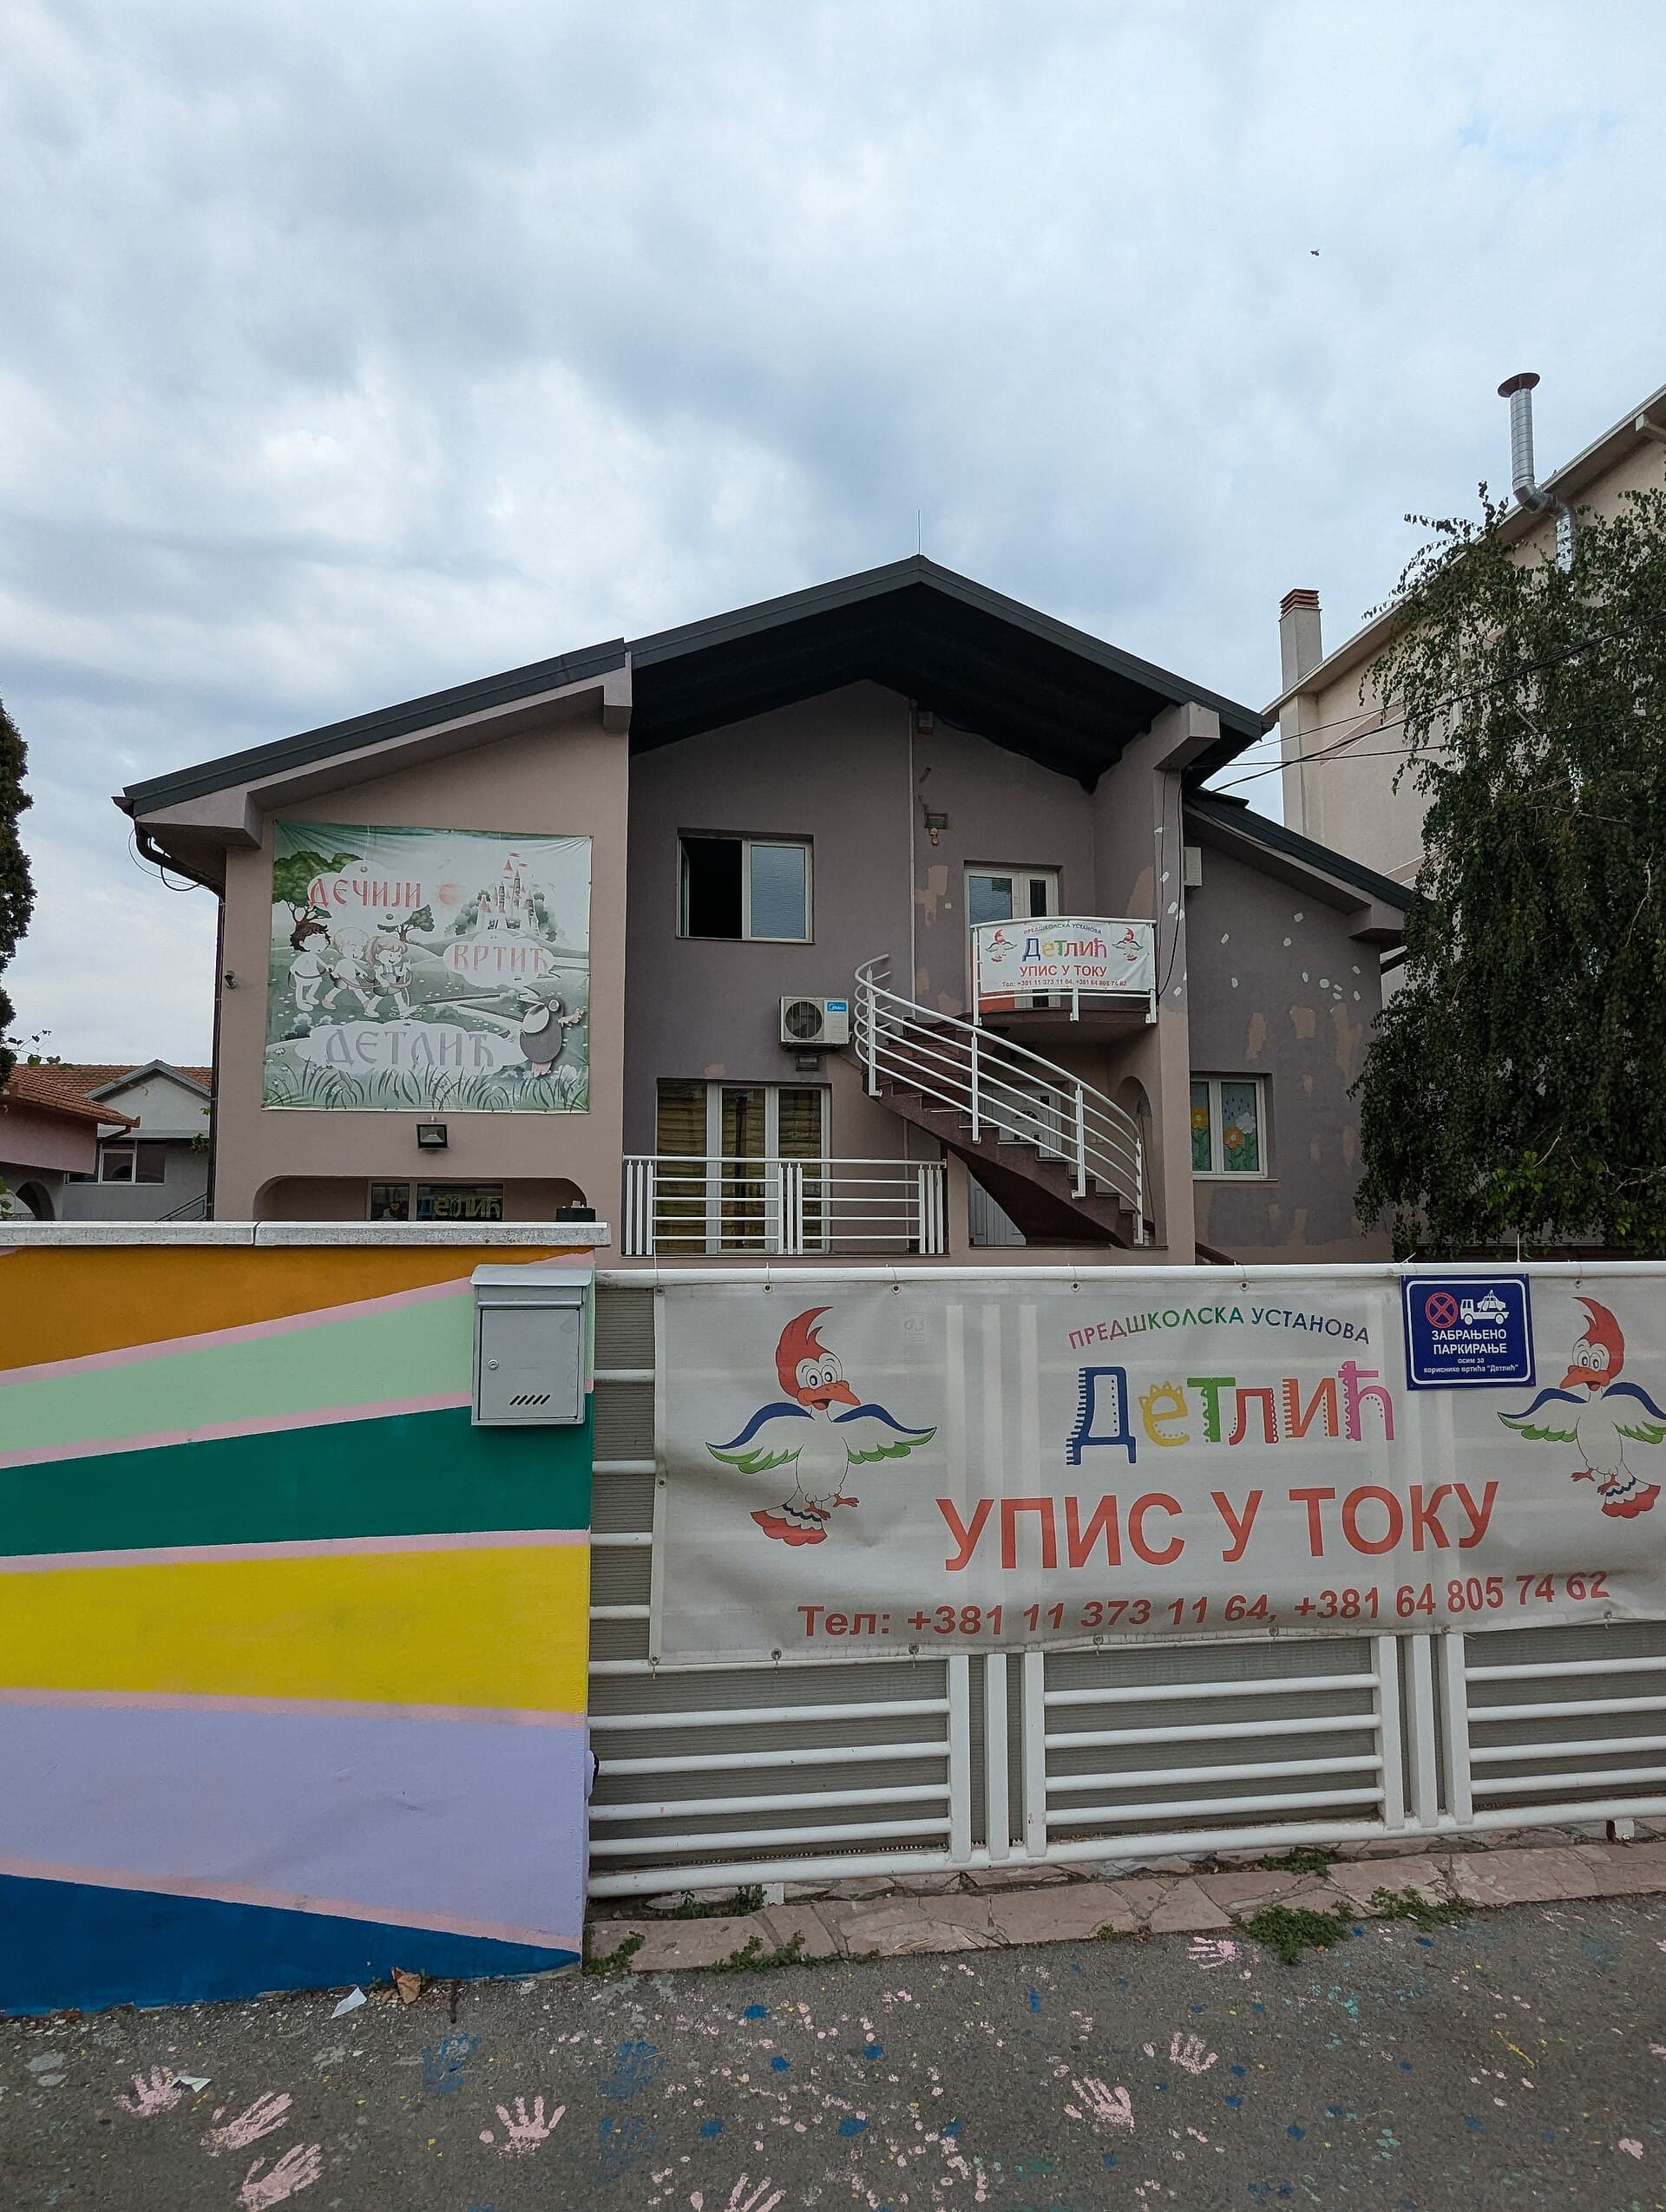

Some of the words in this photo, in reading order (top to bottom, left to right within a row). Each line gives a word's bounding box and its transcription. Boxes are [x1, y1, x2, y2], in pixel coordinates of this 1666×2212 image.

[308, 878, 423, 909] ДЕЧИЈИ
[453, 943, 548, 973] ВРТИЋ
[1021, 938, 1107, 962] Детлић
[1020, 965, 1057, 977] УПИС
[1062, 965, 1070, 976] У
[1073, 965, 1107, 977] ТОКУ
[325, 1029, 494, 1067] ДЕТЛИЋ
[1067, 1306, 1244, 1350] ПРЕДШКОЛСКА
[1250, 1306, 1370, 1346] УСТАНОВА
[1432, 1329, 1507, 1340] ЗАБРАЊЕНО
[1433, 1343, 1507, 1354] ПАРКИРАЊЕ
[1066, 1360, 1395, 1466] Детлић
[935, 1492, 1185, 1571] УПИС
[1210, 1489, 1263, 1562] У
[1289, 1481, 1499, 1558] ТОКУ
[797, 1605, 890, 1638] Тел:
[907, 1604, 1003, 1636] +381
[1022, 1601, 1066, 1632] 11
[1080, 1598, 1151, 1628] 373
[1166, 1596, 1209, 1626] 11
[1224, 1594, 1278, 1624] 64,
[1293, 1587, 1380, 1620] +381
[1395, 1583, 1436, 1618] 64
[1446, 1575, 1505, 1613] 805
[1515, 1573, 1556, 1606] 74
[1565, 1570, 1610, 1601] 62
